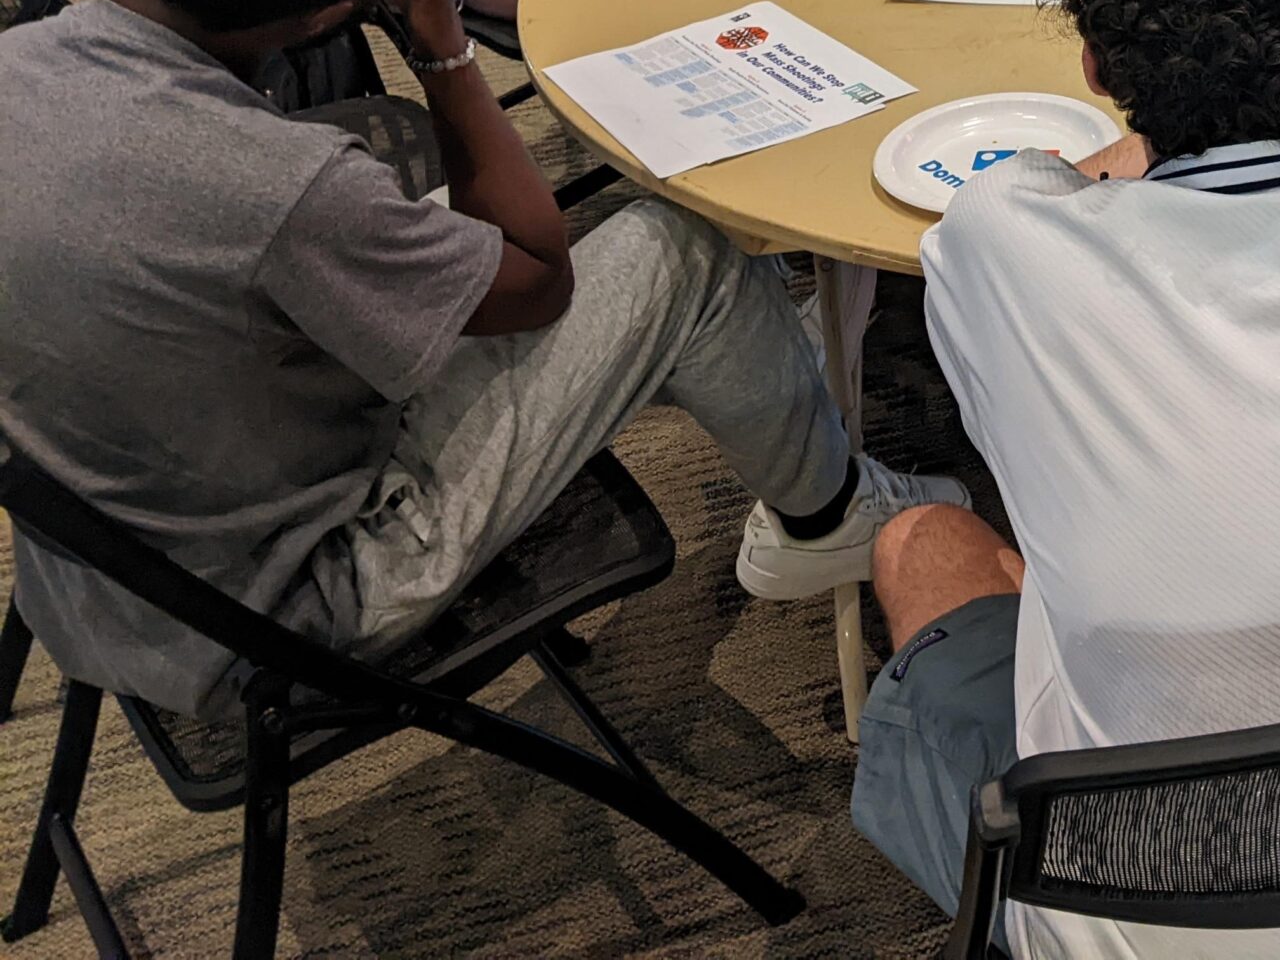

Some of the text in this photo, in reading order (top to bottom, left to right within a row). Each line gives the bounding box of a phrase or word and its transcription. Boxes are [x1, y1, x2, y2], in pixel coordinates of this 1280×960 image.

[736, 50, 749, 59] in
[746, 56, 765, 68] Our
[762, 67, 824, 104] Communities?
[762, 51, 786, 66] Mass
[782, 64, 827, 91] Shootings
[773, 43, 845, 88] How Can We Stop
